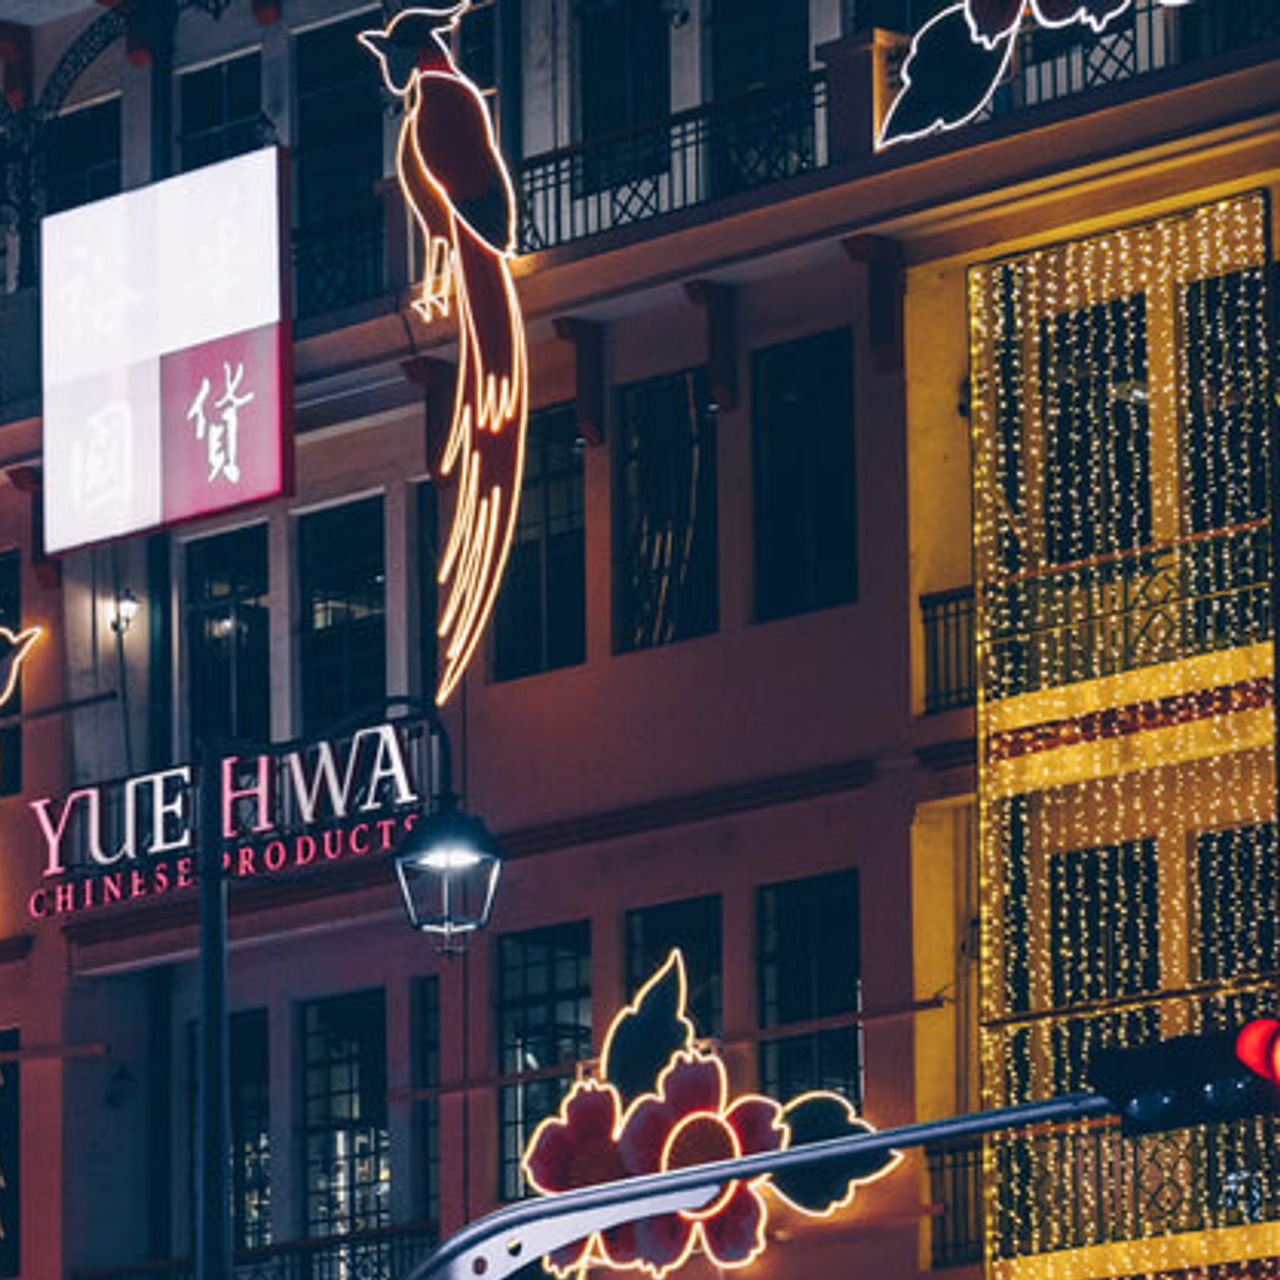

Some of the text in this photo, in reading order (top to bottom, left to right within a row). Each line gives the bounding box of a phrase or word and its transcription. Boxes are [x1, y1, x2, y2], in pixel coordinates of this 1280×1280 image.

[30, 723, 418, 877] YUE HWA
[28, 856, 195, 918] CHINESE
